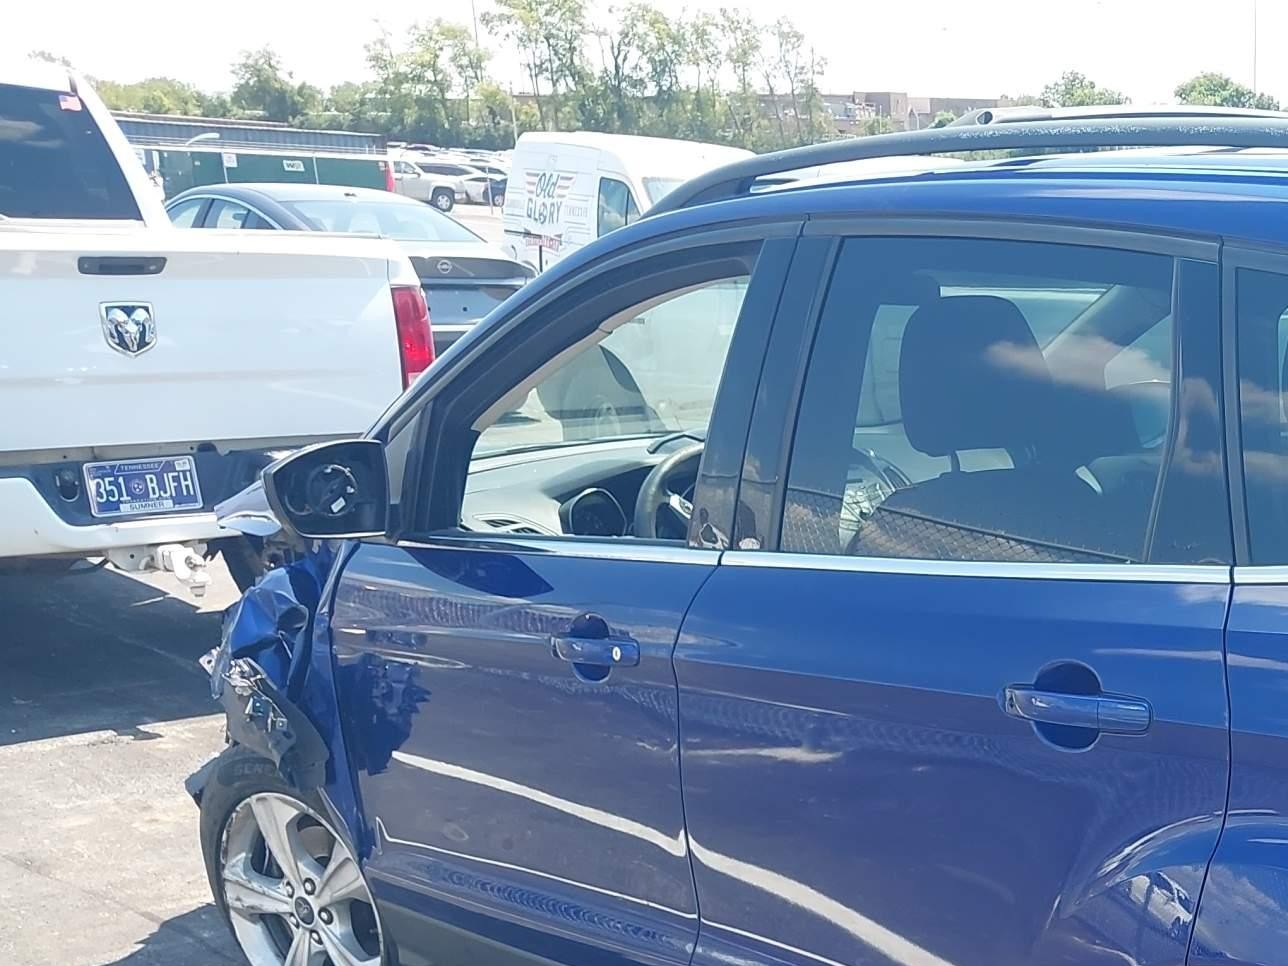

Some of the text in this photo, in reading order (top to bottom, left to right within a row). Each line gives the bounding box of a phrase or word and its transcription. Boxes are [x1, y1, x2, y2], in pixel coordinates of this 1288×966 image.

[536, 172, 560, 198] Old
[120, 463, 159, 471] TENNESSEE
[95, 471, 195, 503] 351 BJFH
[129, 501, 165, 511] SUMNER
